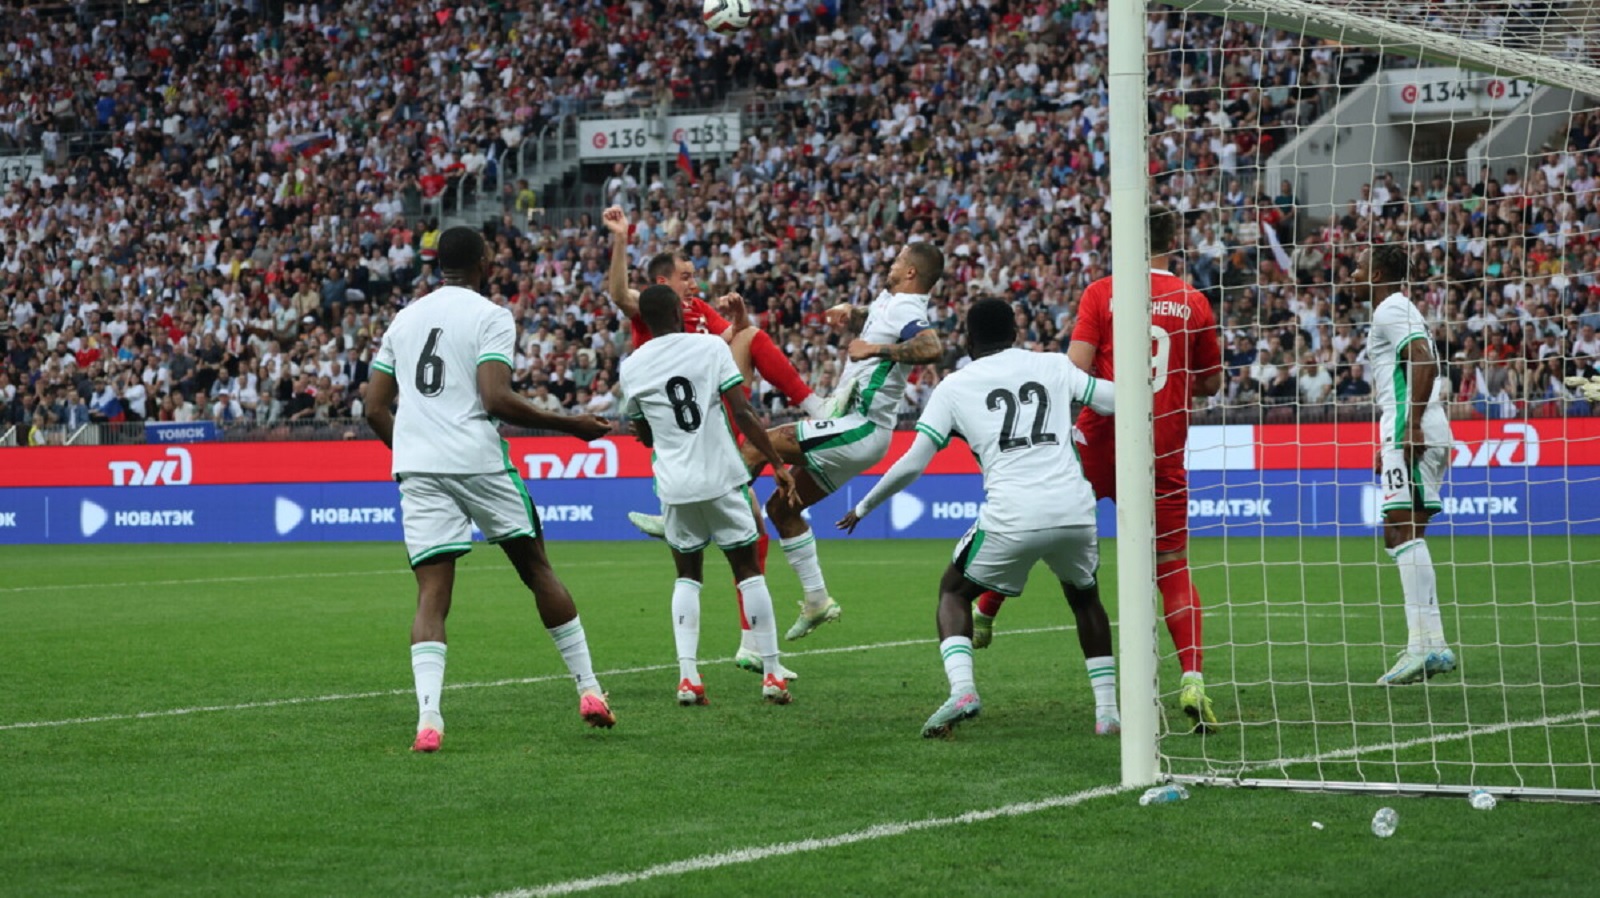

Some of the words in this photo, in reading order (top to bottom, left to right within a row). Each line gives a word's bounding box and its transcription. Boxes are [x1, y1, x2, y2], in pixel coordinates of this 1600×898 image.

[1422, 81, 1467, 103] 134
[609, 128, 647, 149] 136
[416, 327, 446, 398] 6
[665, 376, 703, 434] 8
[985, 381, 1060, 453] 22
[157, 427, 205, 441] ТОМСК
[1385, 467, 1404, 490] 13
[115, 509, 195, 527] НОВАТЭК
[310, 507, 396, 525] НОВАТЭК
